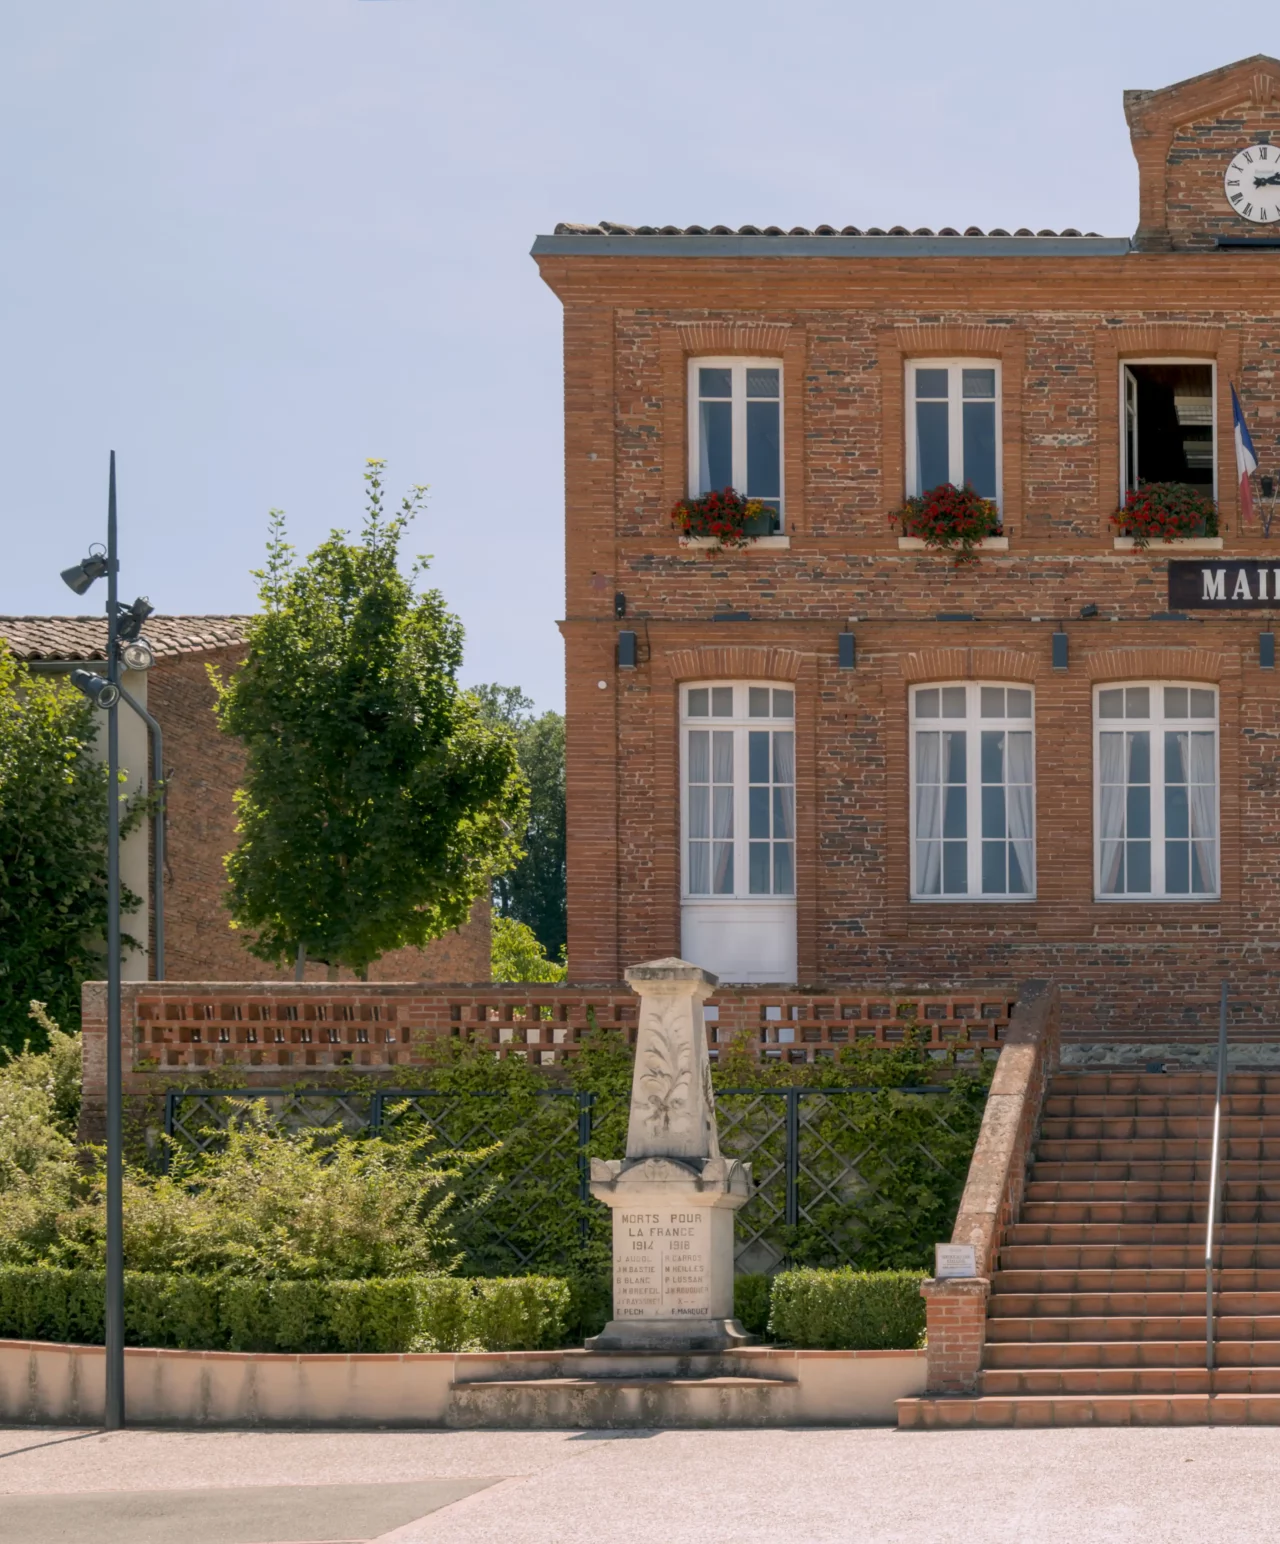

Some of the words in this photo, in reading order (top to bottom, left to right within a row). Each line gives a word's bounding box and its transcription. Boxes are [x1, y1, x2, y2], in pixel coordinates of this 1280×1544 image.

[622, 1214, 660, 1224] MORTS
[670, 1214, 702, 1223] POUR
[629, 1228, 643, 1237] LA
[650, 1228, 695, 1237] FRANCE
[632, 1241, 654, 1250] 1914
[669, 1241, 690, 1250] 1918
